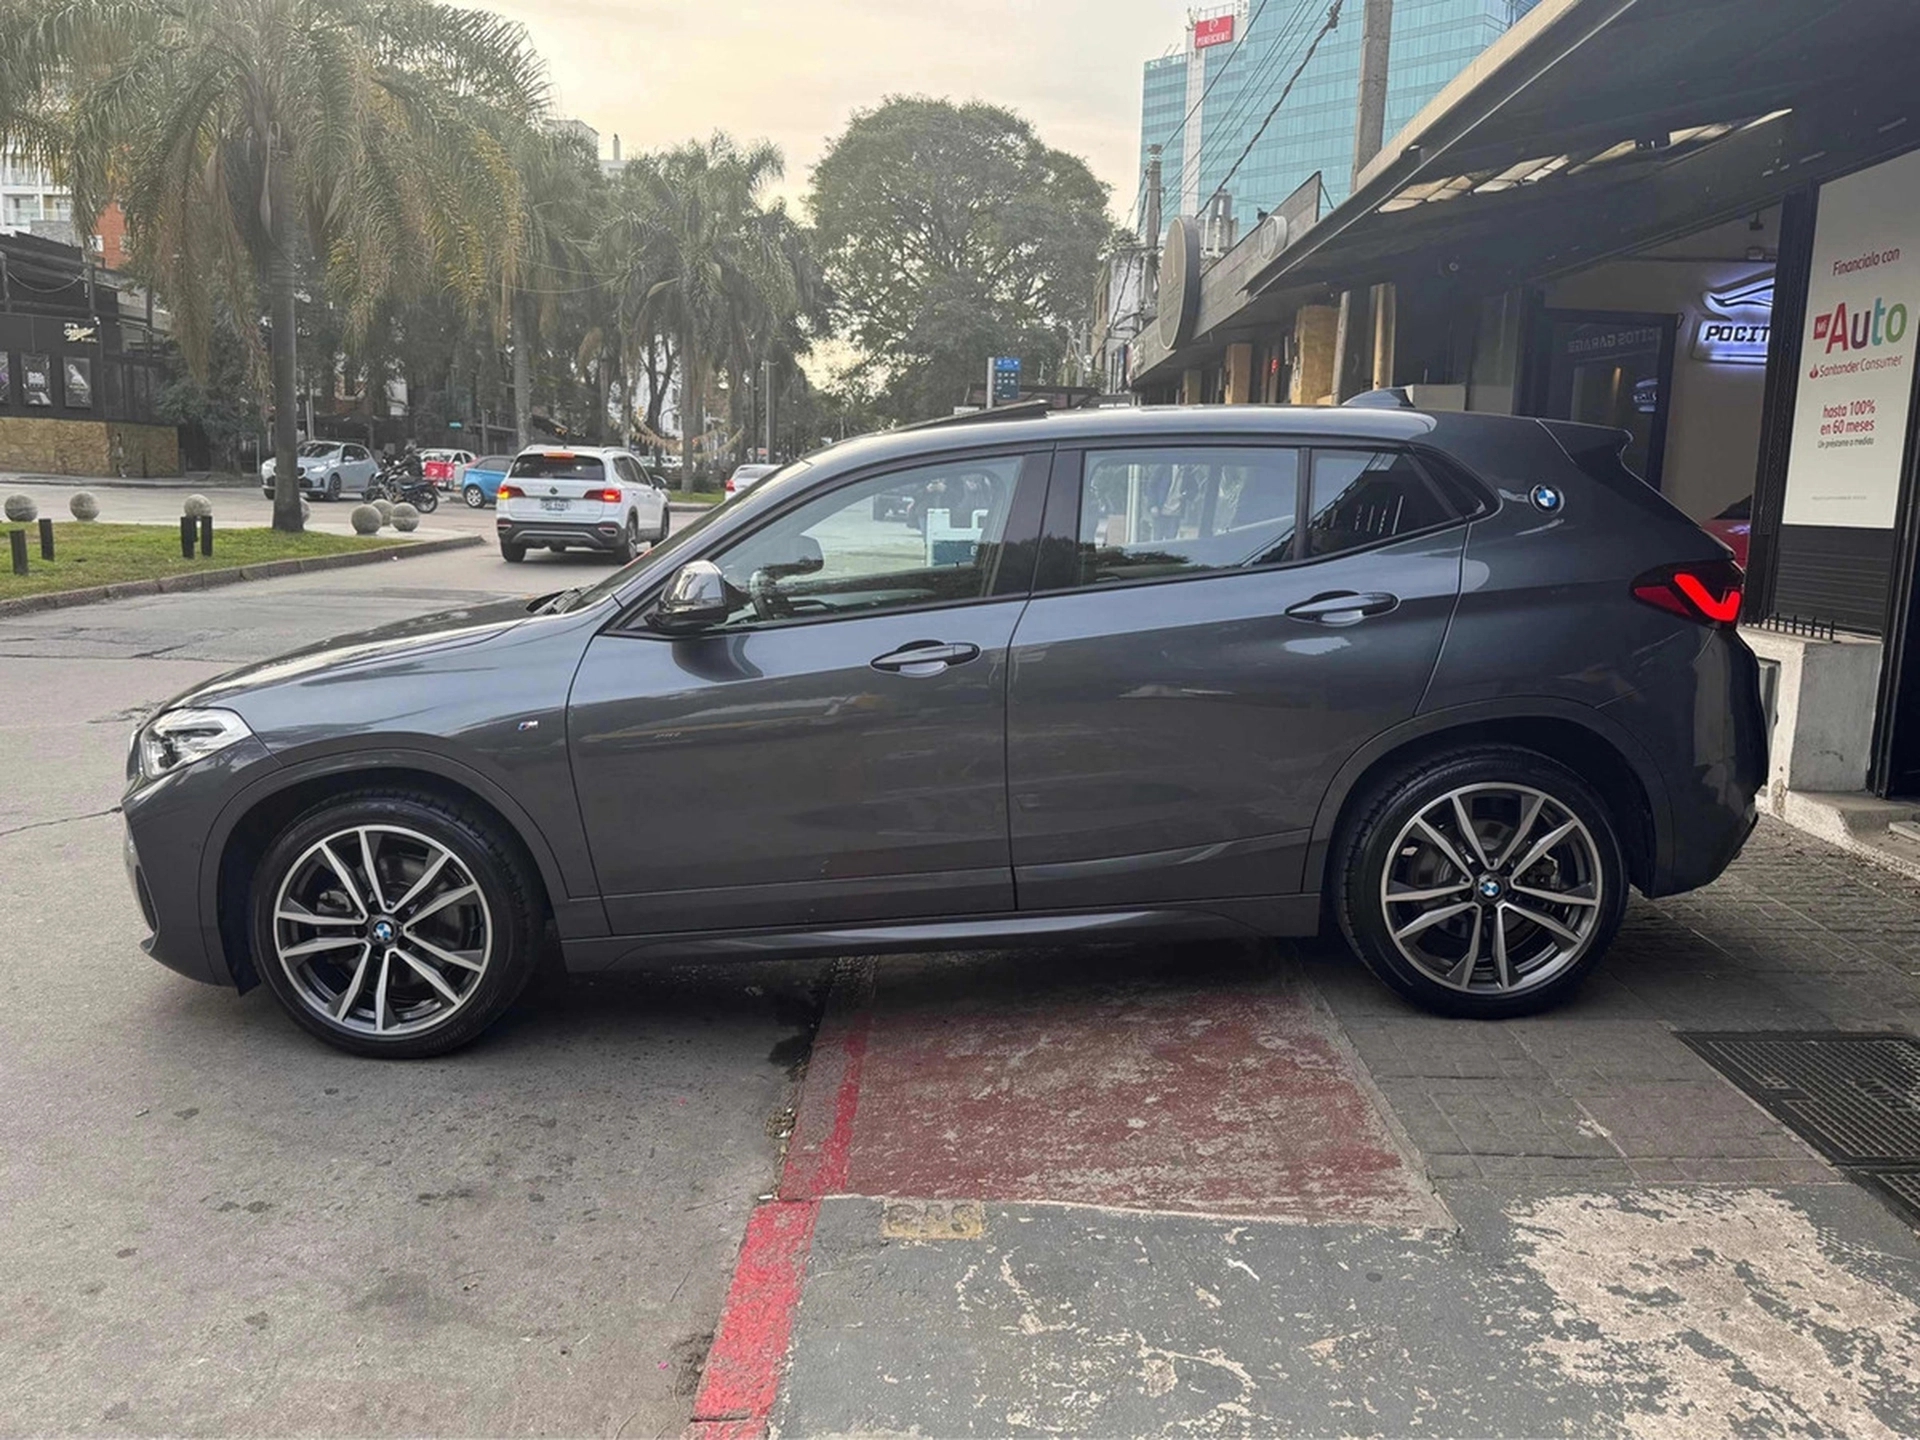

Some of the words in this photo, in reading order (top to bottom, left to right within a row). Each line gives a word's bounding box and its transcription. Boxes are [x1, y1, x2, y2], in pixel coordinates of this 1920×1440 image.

[1882, 248, 1900, 264] con
[1825, 297, 1908, 354] Auto
[1819, 361, 1860, 378] Santander
[1860, 355, 1904, 372] Consumer
[1823, 404, 1847, 418] hasta
[1850, 399, 1876, 416] 100%
[1820, 424, 1831, 436] en
[1833, 419, 1845, 434] 60
[1846, 420, 1875, 433] meses
